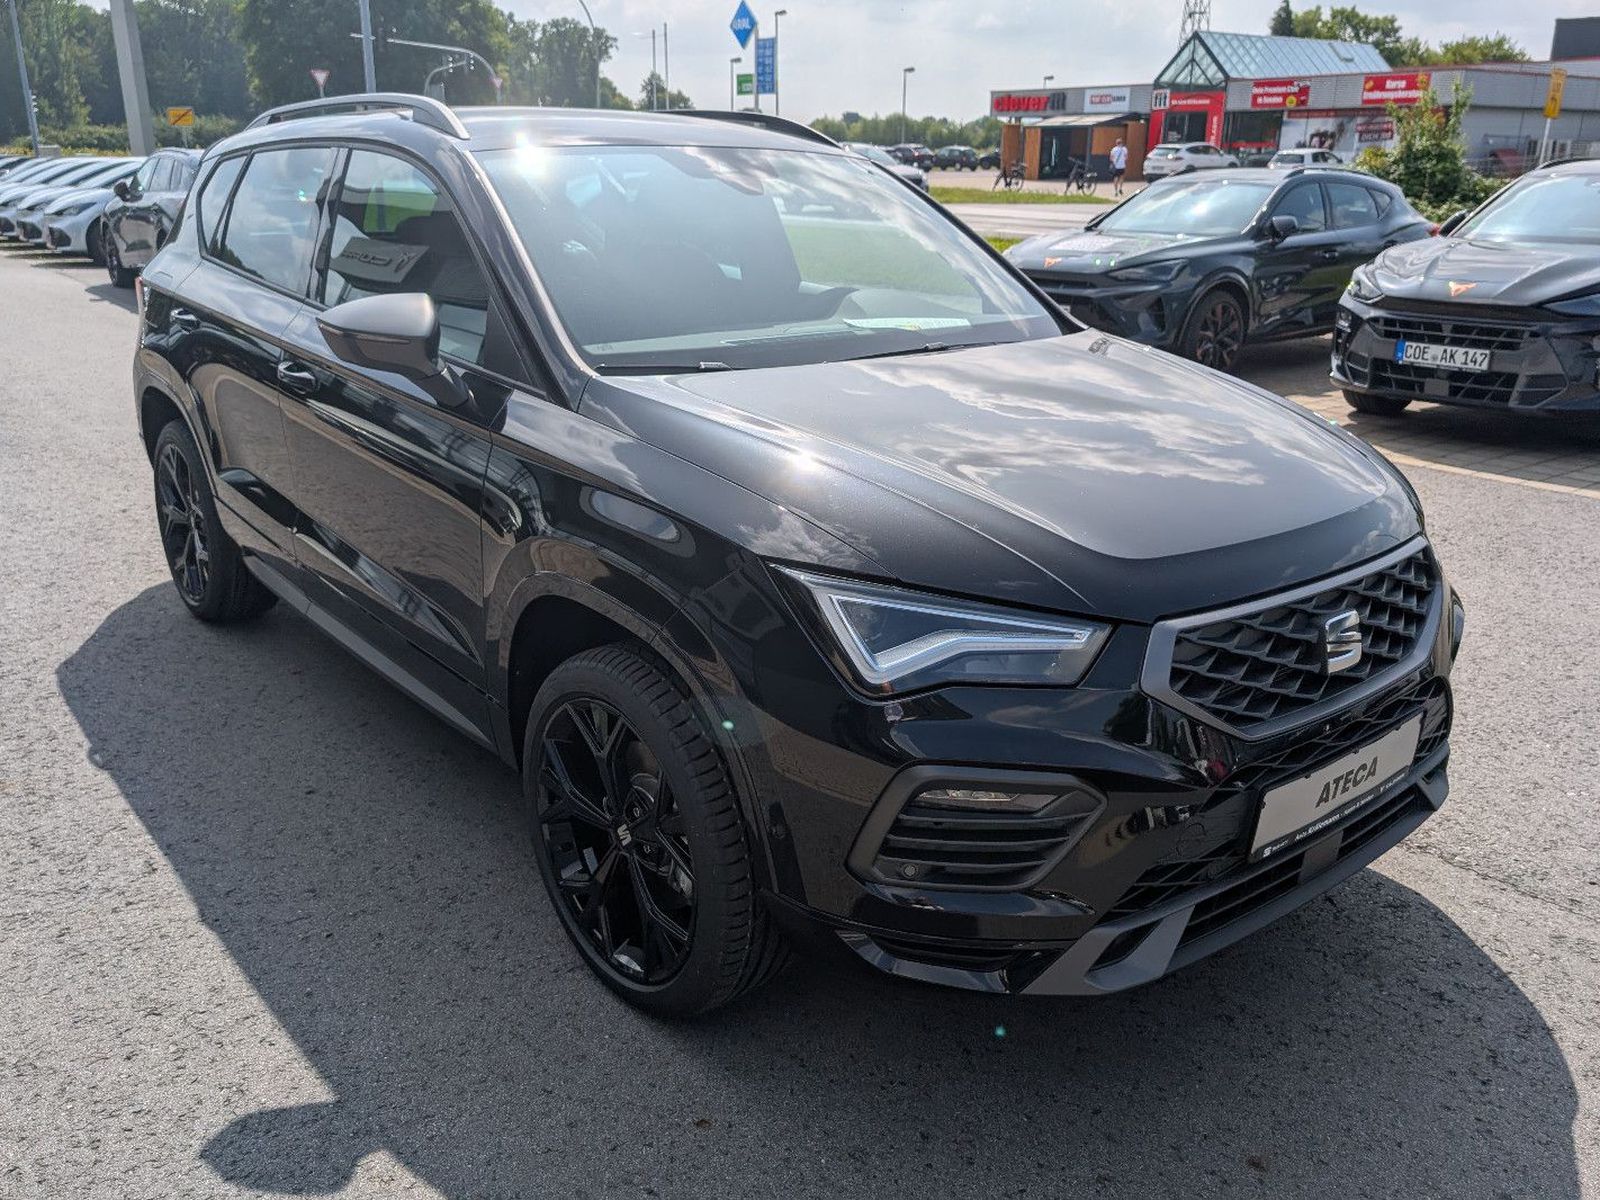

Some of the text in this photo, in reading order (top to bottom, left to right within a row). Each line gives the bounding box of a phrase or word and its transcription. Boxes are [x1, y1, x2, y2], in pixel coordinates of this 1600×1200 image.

[993, 94, 1049, 112] clever
[1404, 344, 1488, 367] COE AK 147
[1315, 756, 1379, 808] ATECA
